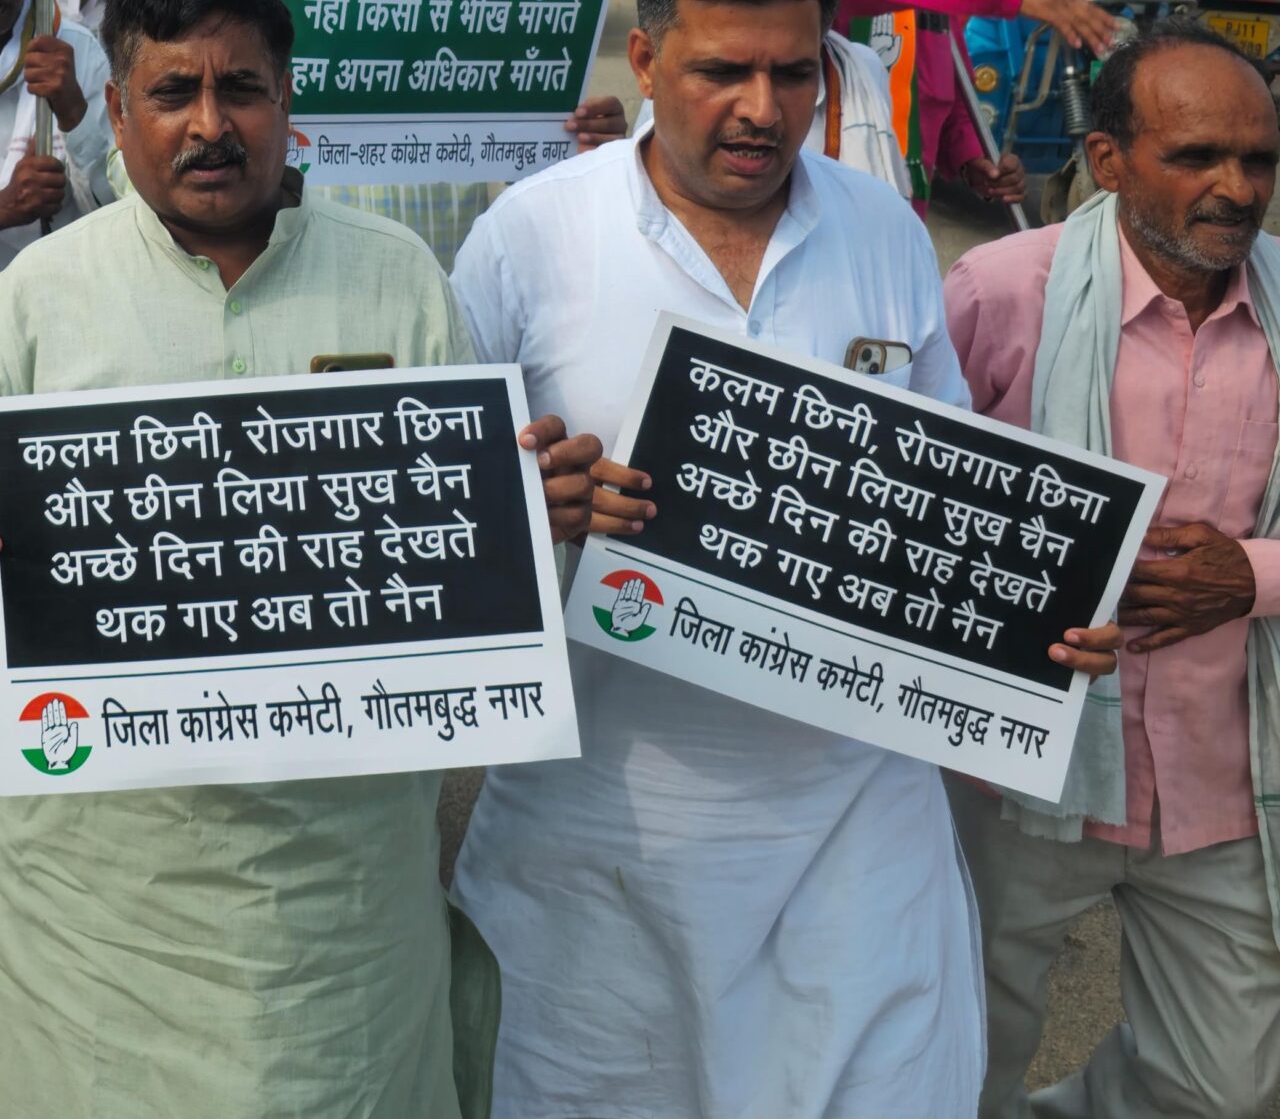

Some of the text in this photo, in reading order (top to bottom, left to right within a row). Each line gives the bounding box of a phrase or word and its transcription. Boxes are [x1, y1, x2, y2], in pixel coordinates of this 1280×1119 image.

[292, 47, 572, 95] हम अपना अधिकार माँगते
[391, 134, 432, 164] कांग्रेस
[436, 134, 474, 166] कमेटी,
[481, 133, 538, 171] गौतमबुद्ध
[543, 141, 571, 160] नगर
[19, 397, 483, 470] कलम छिनी, रोजगार छिना
[690, 358, 1110, 523] कलम छिनी, रोजगार छिना
[45, 453, 471, 526] और छीन लिया सुख चैन
[690, 410, 1074, 566] और छीन लिया सुख चैन
[51, 509, 477, 585] अच्छे दिन की राह देखते
[677, 464, 1056, 612] अच्छे दिन की राह देखते
[96, 573, 443, 642] थक गए अब तो नैन
[700, 525, 1003, 649] थक गए अब तो नैन
[101, 679, 544, 747] जिला कांग्रेस कमेटी, गौतमबुद्ध नगर
[670, 597, 1049, 758] जिला कांग्रेस कमेटी, गौतमबुद्ध नगर
